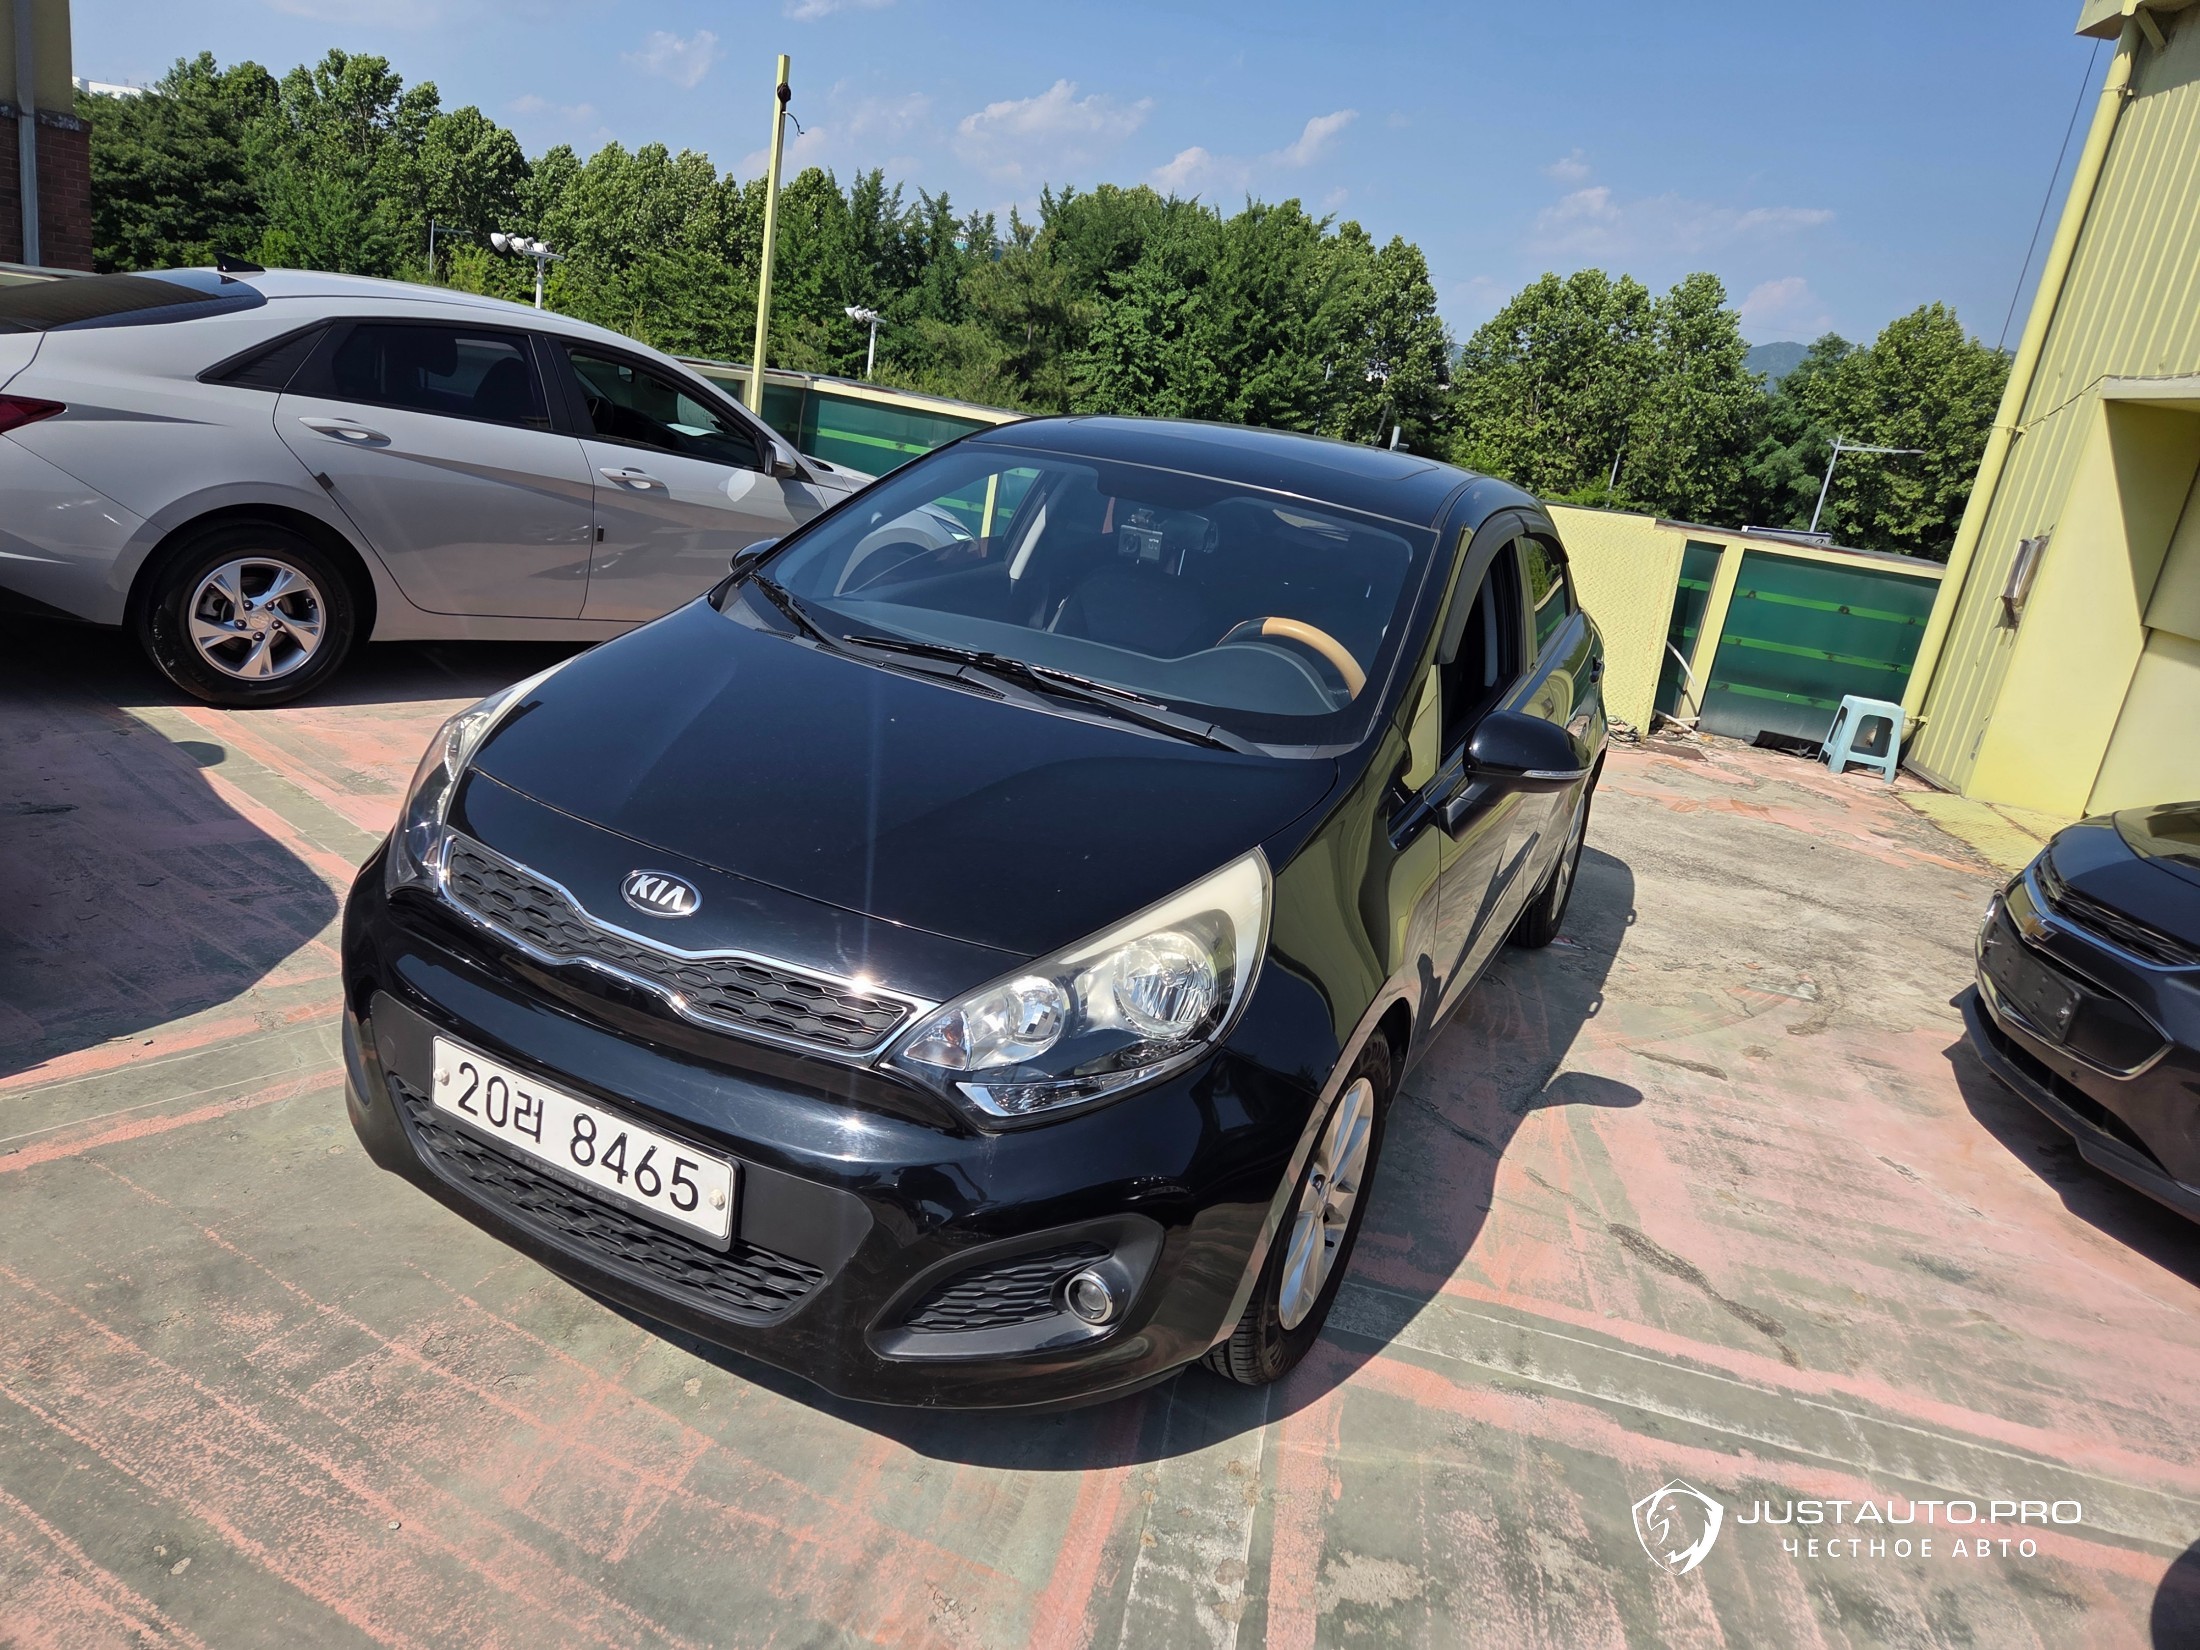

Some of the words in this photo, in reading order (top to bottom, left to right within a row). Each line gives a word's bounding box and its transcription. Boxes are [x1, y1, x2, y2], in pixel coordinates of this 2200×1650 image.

[629, 874, 686, 911] KIA
[457, 1061, 544, 1145] 20러
[570, 1112, 699, 1212] 8465
